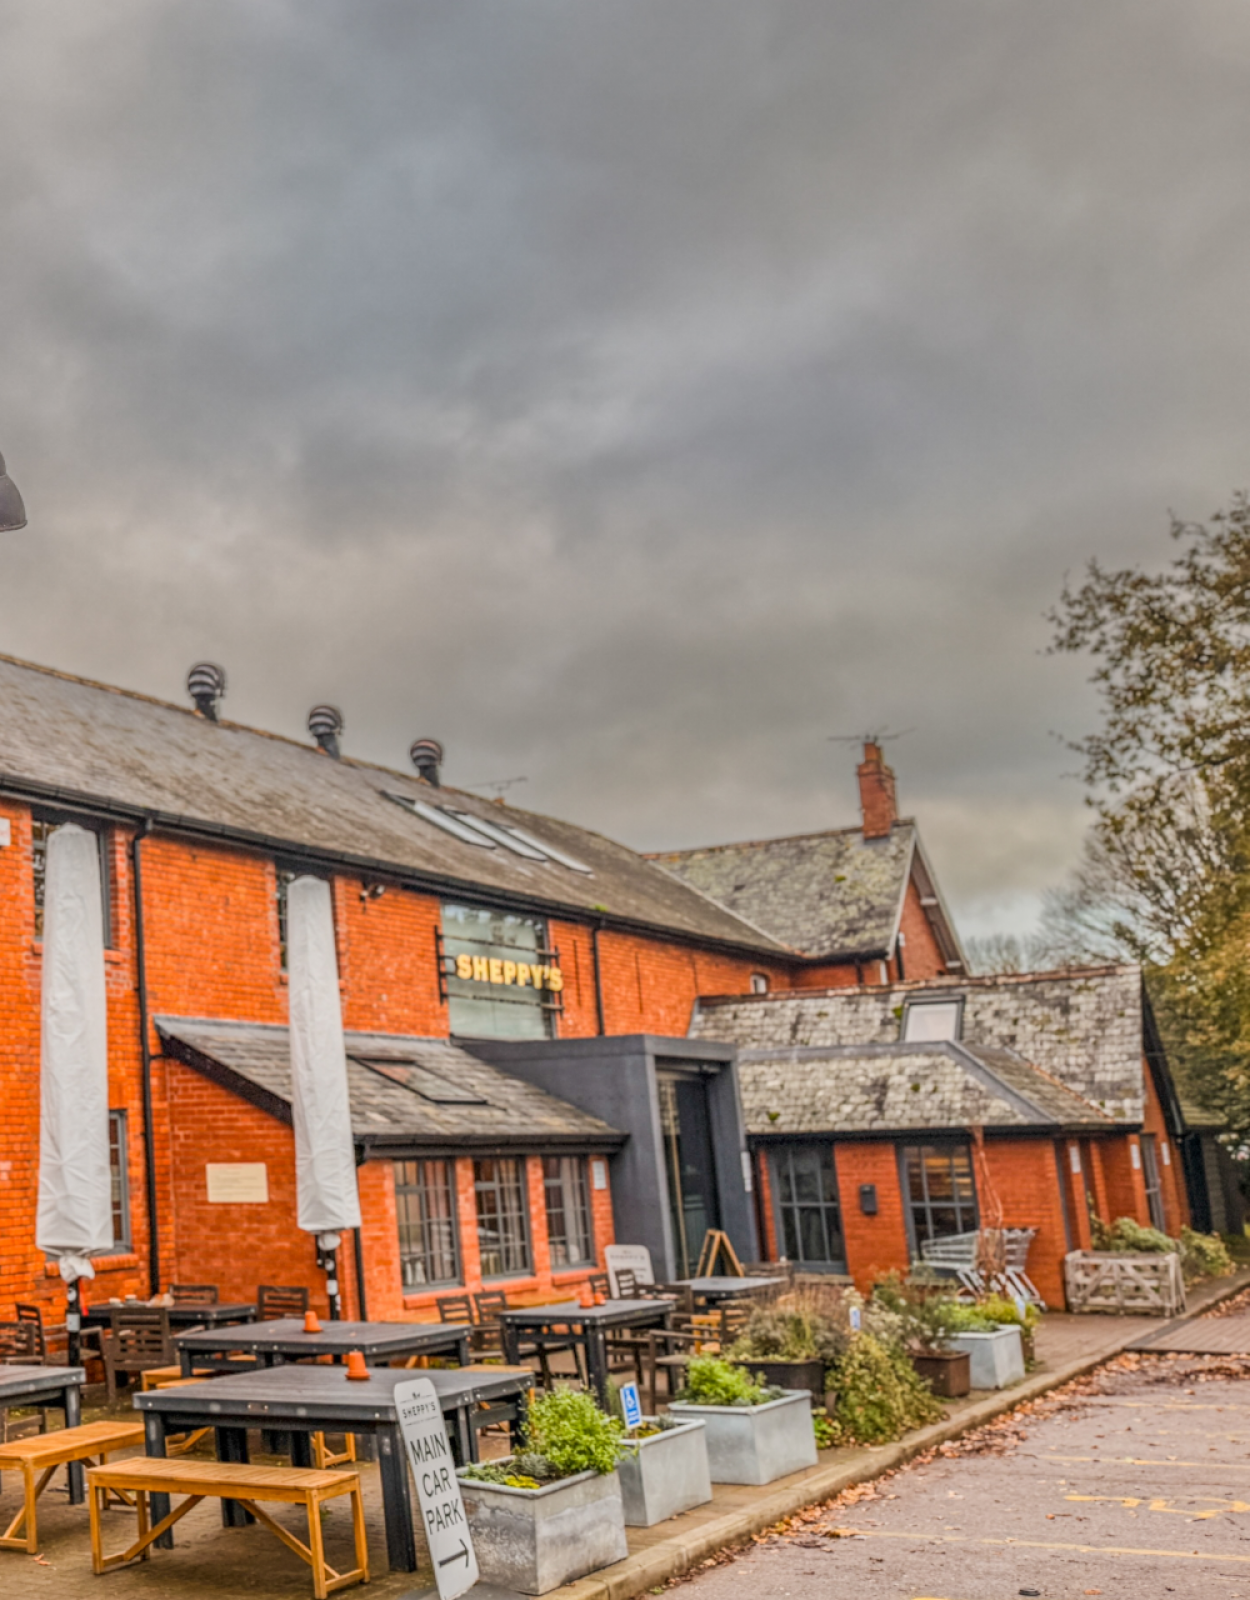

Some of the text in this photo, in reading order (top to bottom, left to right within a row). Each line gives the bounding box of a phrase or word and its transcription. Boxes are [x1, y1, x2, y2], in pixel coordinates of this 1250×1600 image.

[456, 954, 564, 992] SHEPPY'S
[410, 1432, 448, 1466] MAIN
[422, 1467, 452, 1498] CAR
[425, 1498, 464, 1535] PARK
